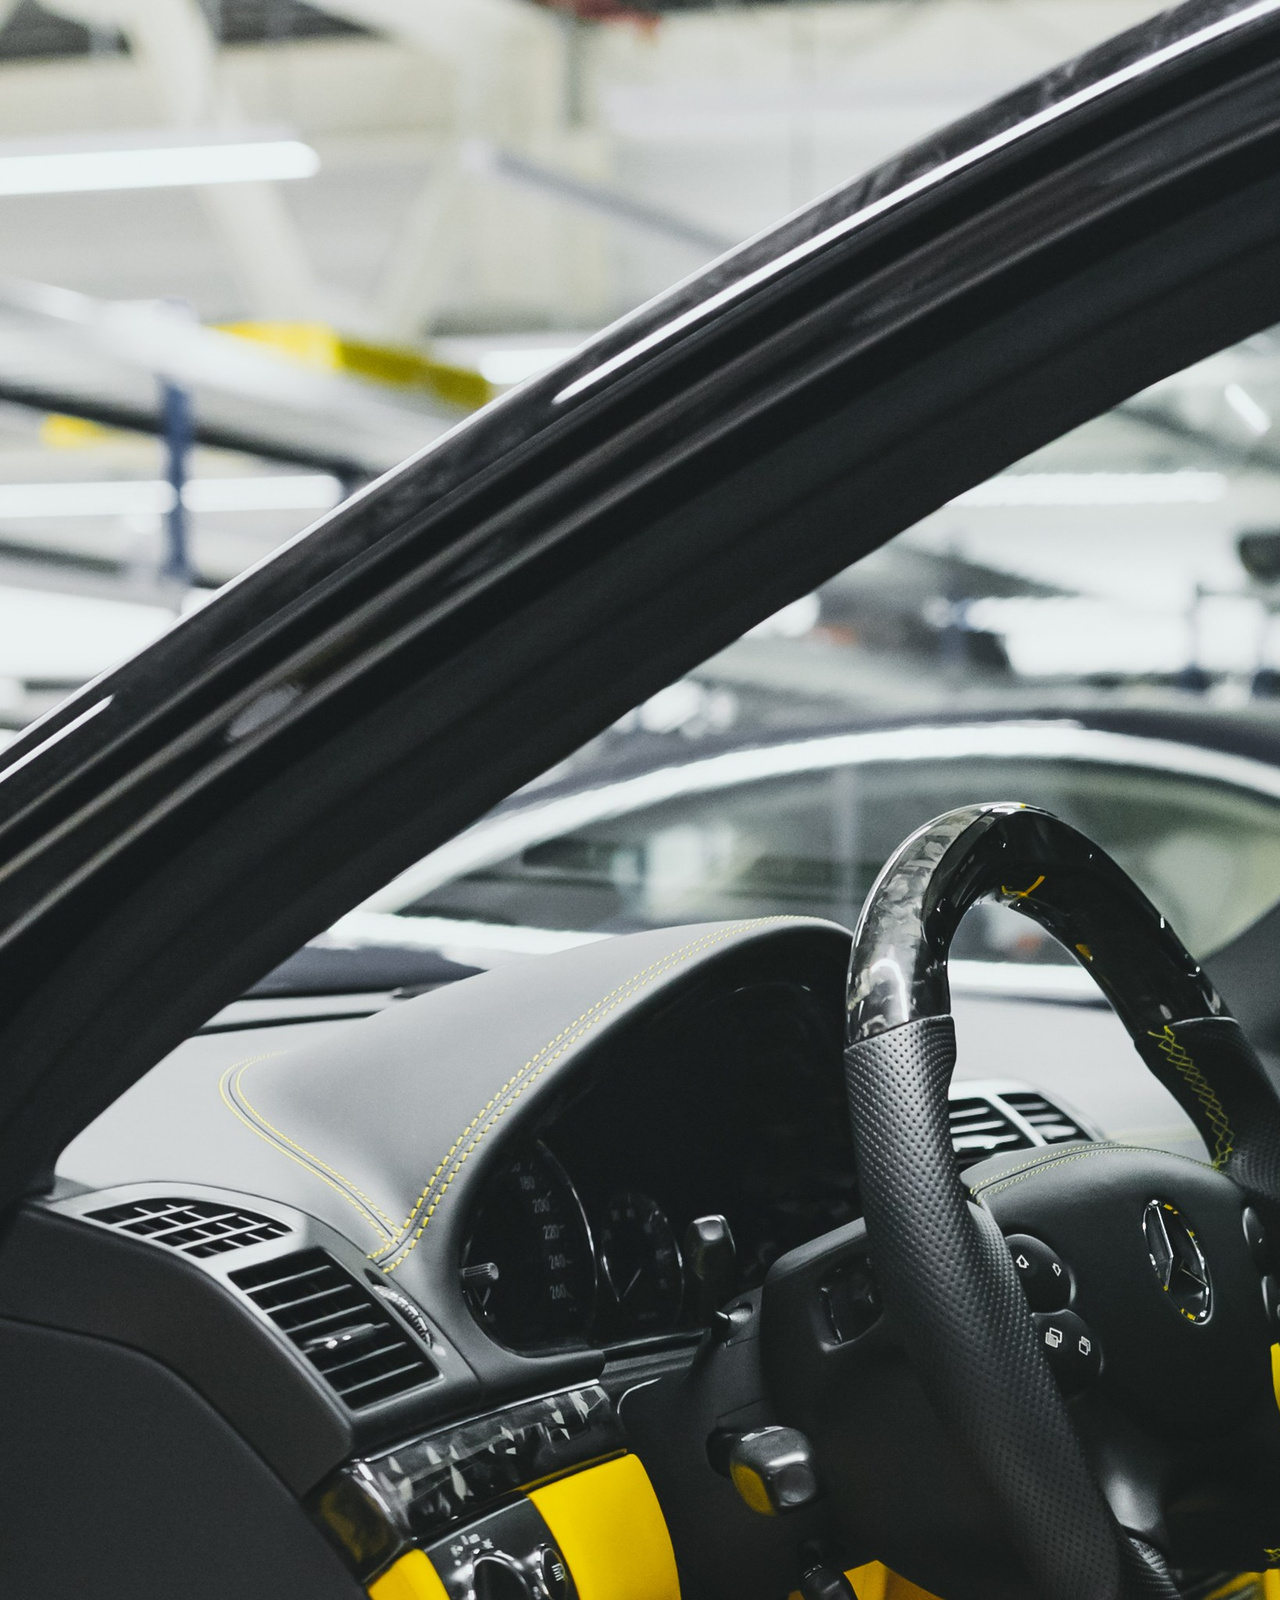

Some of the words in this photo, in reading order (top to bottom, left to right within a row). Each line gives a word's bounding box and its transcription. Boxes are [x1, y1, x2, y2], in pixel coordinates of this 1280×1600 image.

[532, 1198, 551, 1214] 200
[543, 1224, 560, 1240] 220
[549, 1253, 566, 1270] 240
